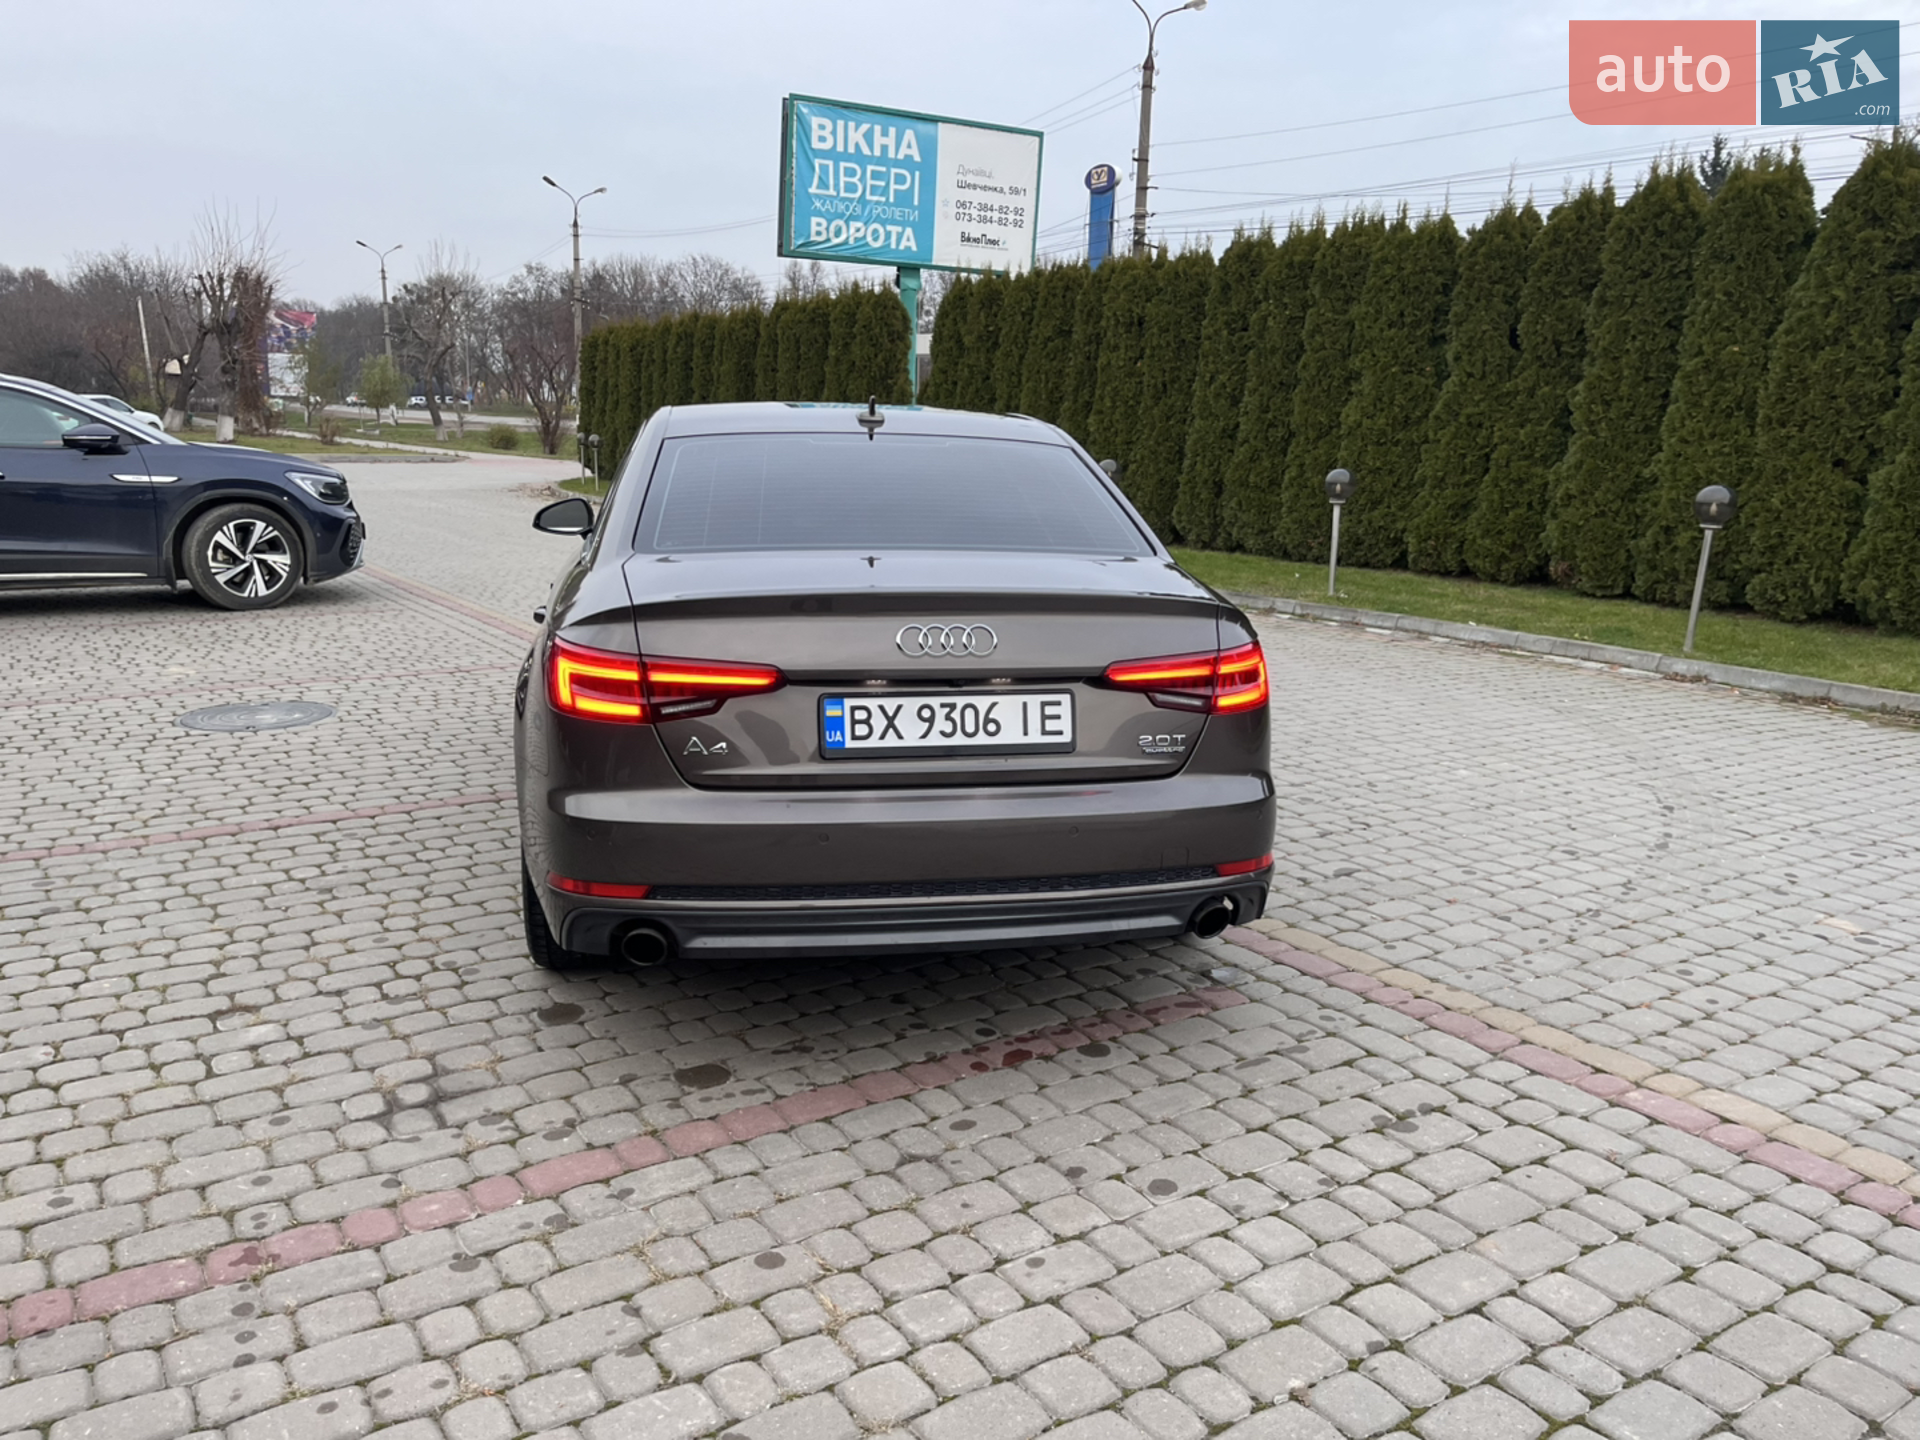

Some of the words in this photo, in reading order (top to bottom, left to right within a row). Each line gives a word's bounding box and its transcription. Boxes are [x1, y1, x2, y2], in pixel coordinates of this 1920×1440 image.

[811, 116, 922, 162] ВІКНА
[807, 158, 920, 206] ДВЕРІ
[956, 179, 1006, 196] Шевченка,
[1008, 186, 1027, 197] 59/1
[811, 197, 862, 216] ЖАЛЮЗІ
[872, 204, 919, 222] РОЛЕТИ
[955, 199, 1025, 217] 067-384-82-92
[955, 211, 1024, 229] 073-384-82-92
[810, 216, 918, 252] ВОРОТА
[850, 704, 904, 741] BX
[916, 702, 1002, 739] 9306
[1022, 700, 1064, 737] IE
[683, 736, 728, 756] A4
[826, 730, 843, 742] UA
[1138, 734, 1186, 746] 2.0T
